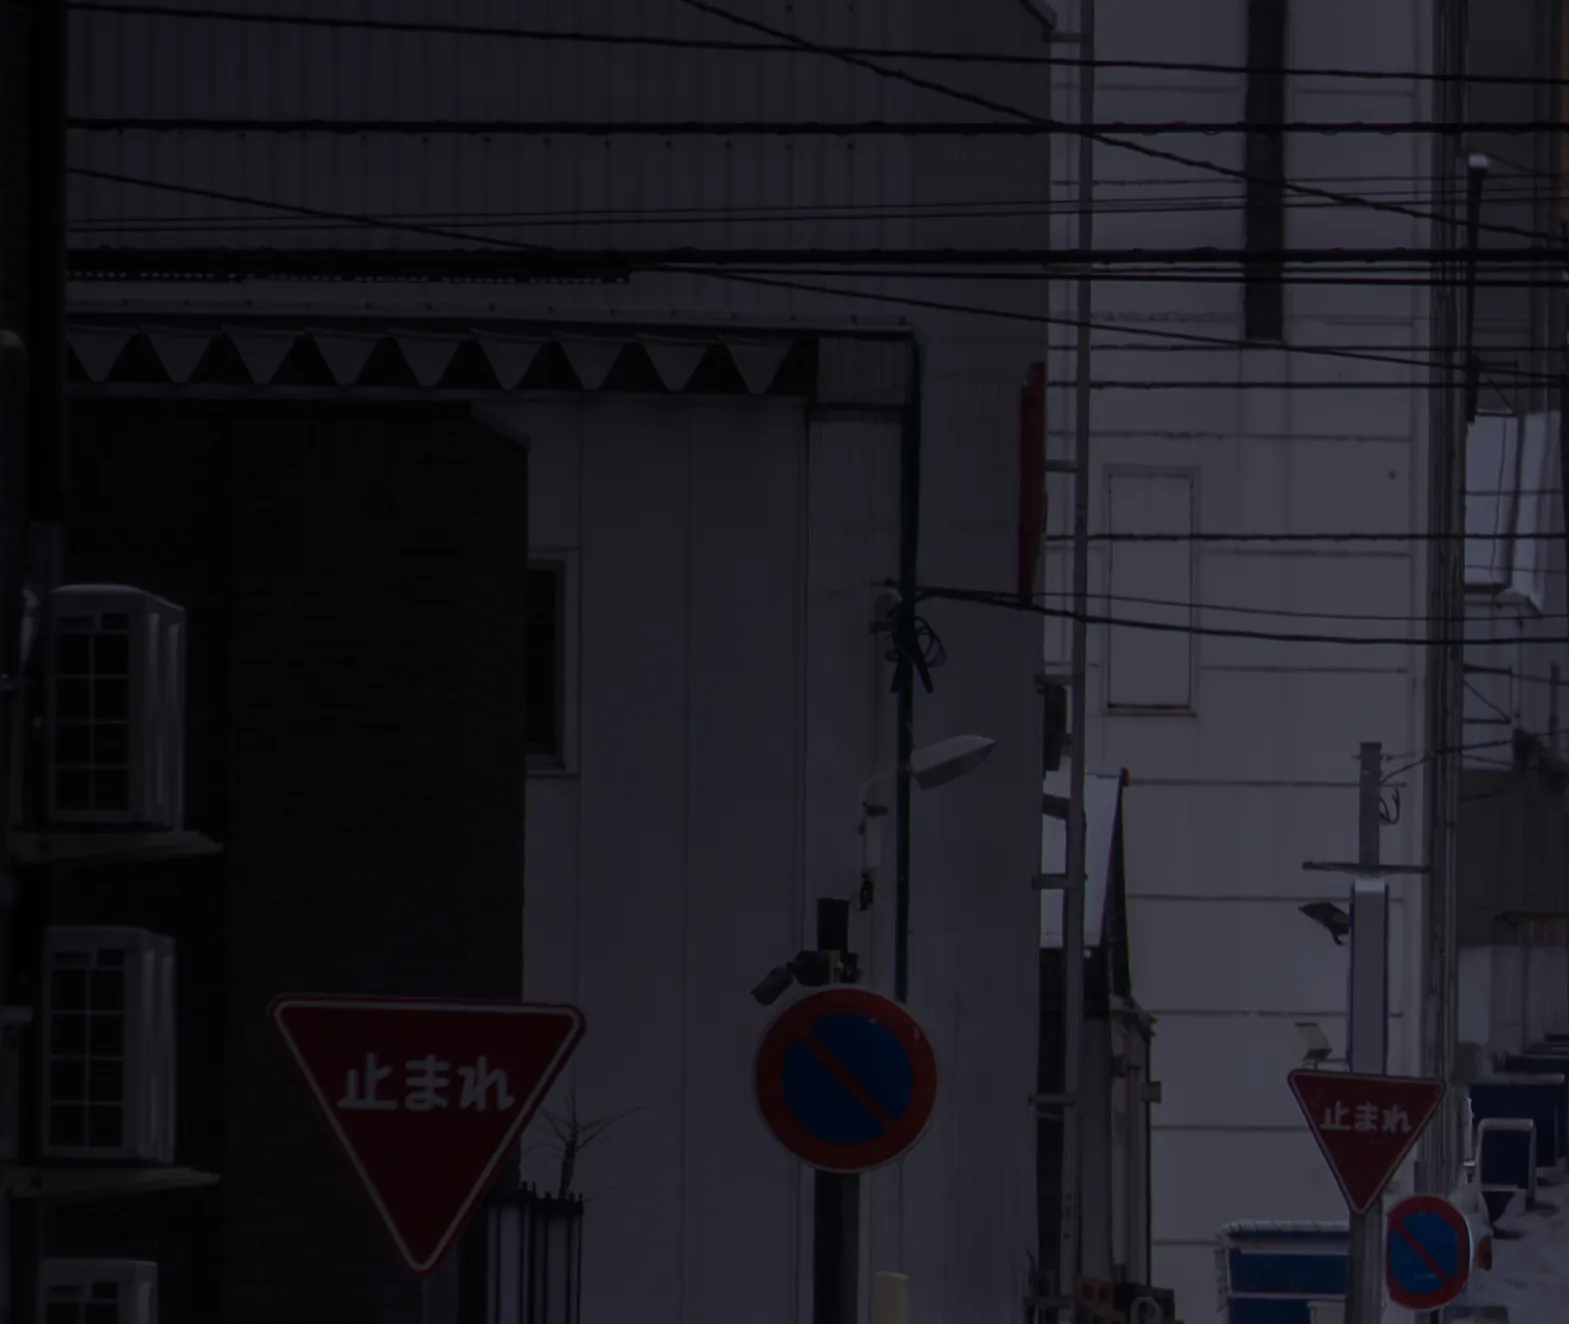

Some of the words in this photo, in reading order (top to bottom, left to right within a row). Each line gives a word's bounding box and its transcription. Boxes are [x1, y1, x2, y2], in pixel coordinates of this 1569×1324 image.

[337, 1051, 516, 1112] 止まれ
[1320, 1100, 1413, 1134] 止まれ
